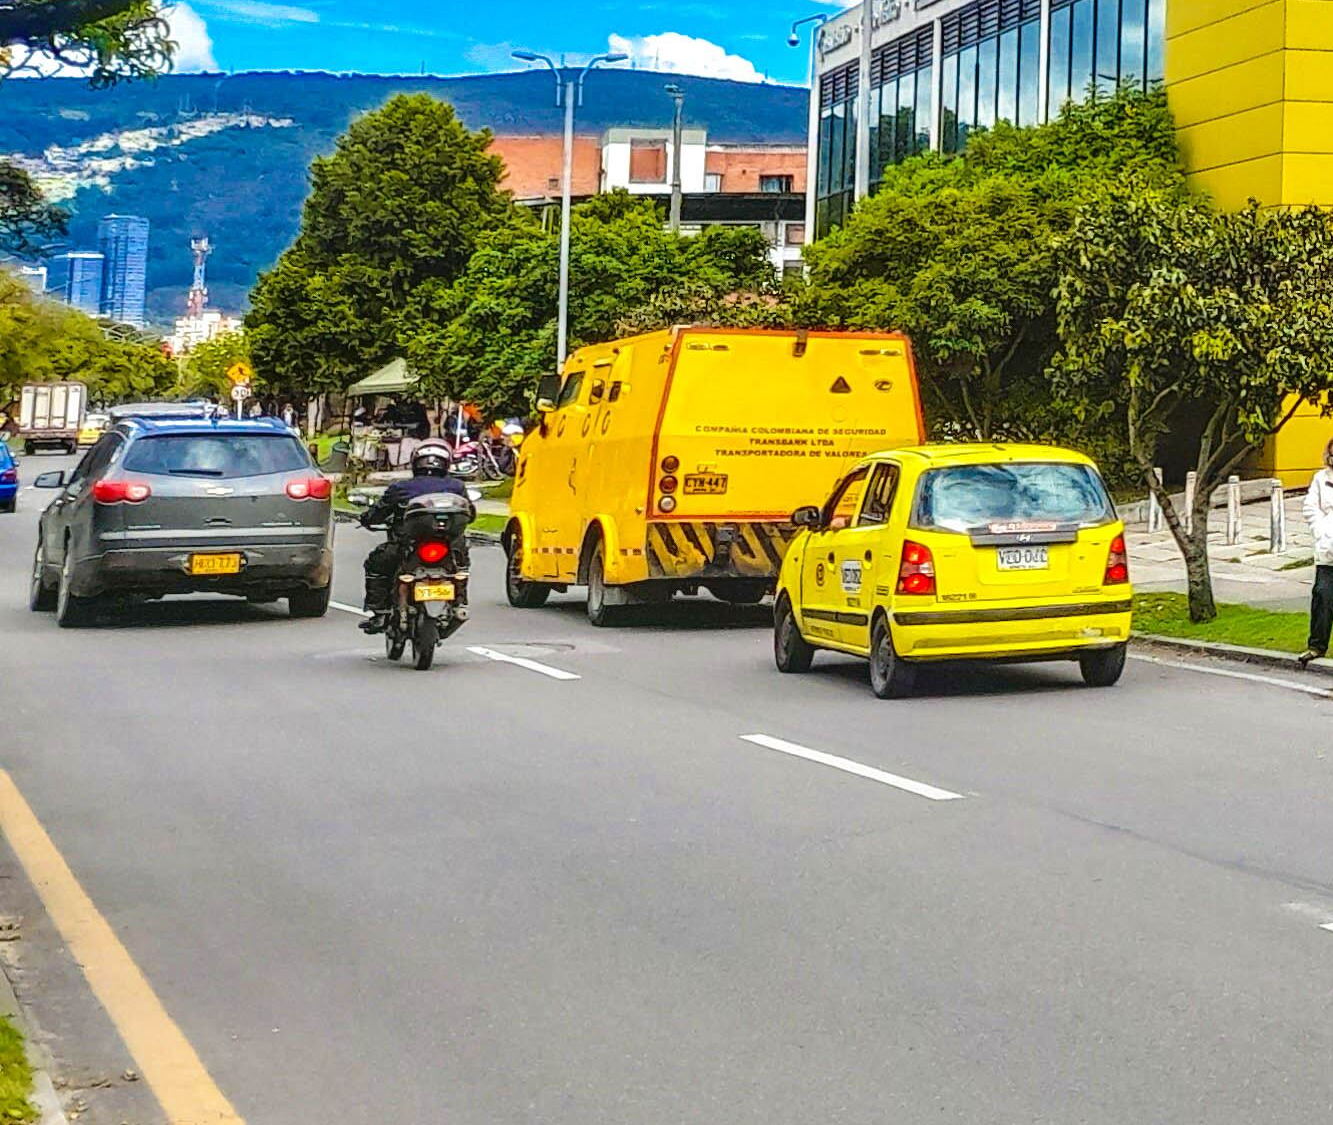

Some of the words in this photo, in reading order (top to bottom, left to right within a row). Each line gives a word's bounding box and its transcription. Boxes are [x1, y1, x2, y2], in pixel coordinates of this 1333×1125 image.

[751, 427, 814, 435] COLOMBIANA
[833, 428, 887, 436] SEGURIDAD
[715, 449, 806, 457] TRANSPORTADORA
[825, 450, 868, 458] VALORES
